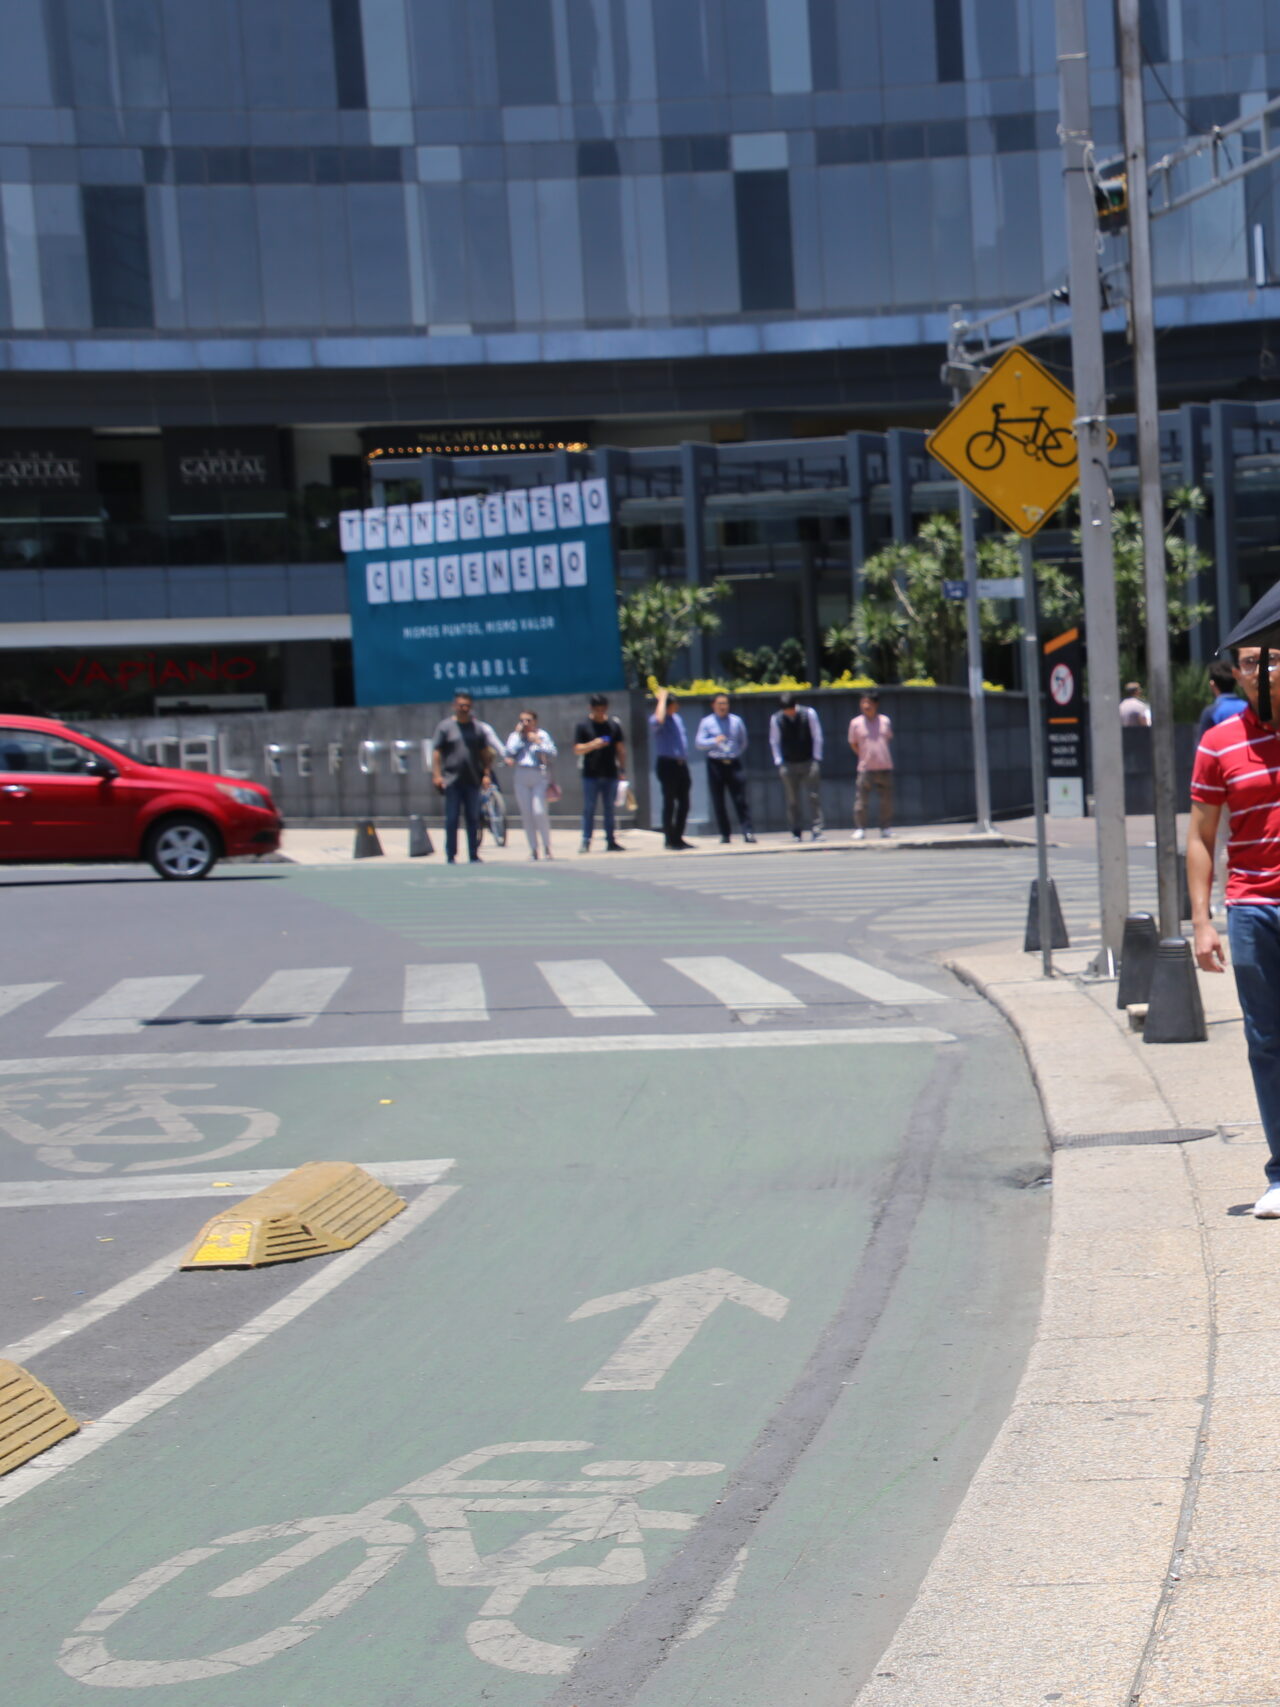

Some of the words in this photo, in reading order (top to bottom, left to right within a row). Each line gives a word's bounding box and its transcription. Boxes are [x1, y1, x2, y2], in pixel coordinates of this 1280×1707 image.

[180, 457, 267, 475] CAPITAL
[346, 488, 601, 539] TRANSGENERO
[372, 551, 582, 591] CISGENERO
[433, 657, 529, 680] SCRABBLE
